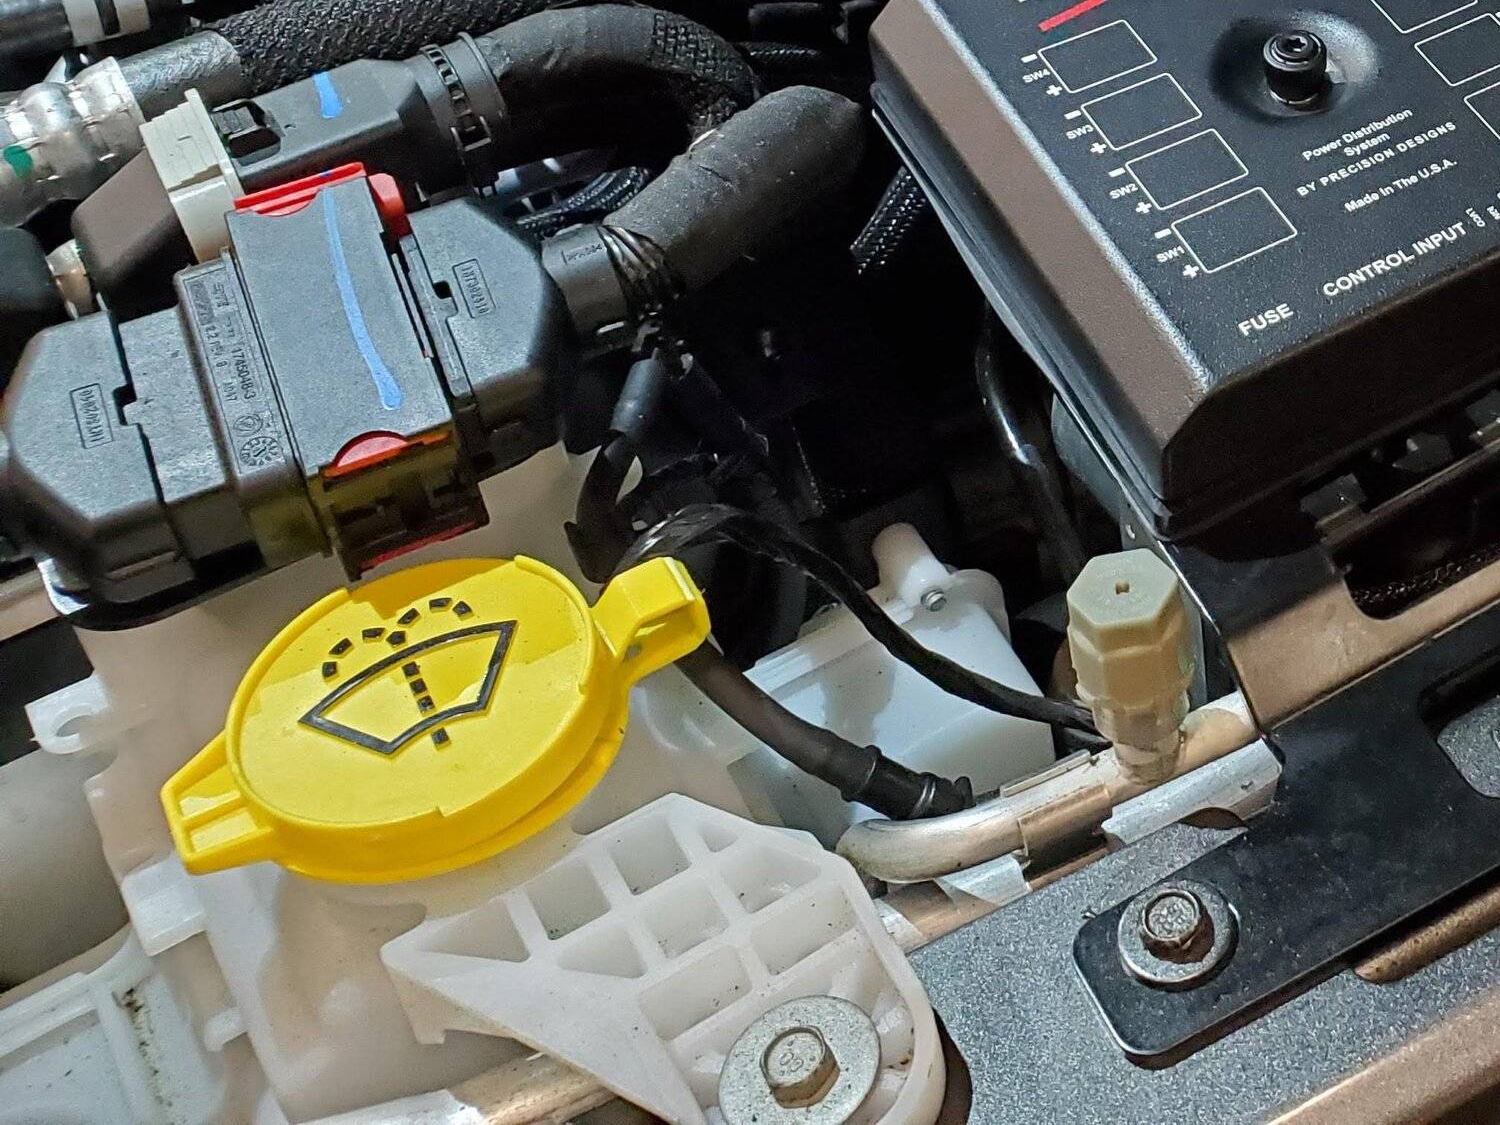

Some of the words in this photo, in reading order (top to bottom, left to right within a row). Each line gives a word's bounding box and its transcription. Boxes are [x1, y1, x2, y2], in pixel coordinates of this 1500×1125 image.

[1022, 67, 1051, 84] SW4
[1065, 123, 1094, 141] SW3
[1302, 138, 1343, 161] Power
[1341, 109, 1414, 144] Distribution
[1343, 132, 1391, 157] System
[1296, 181, 1317, 197] BY
[1319, 148, 1395, 187] PRECISION
[1396, 121, 1457, 153] DESIGNS
[1108, 182, 1138, 200] SW2
[1344, 192, 1380, 212] Made
[1379, 184, 1395, 197] In
[1392, 174, 1419, 191] The
[1417, 158, 1458, 179] U.S.A.
[1156, 245, 1185, 263] SW1
[1322, 251, 1414, 298] CONTROL
[1411, 220, 1468, 259] INPUT
[1237, 302, 1294, 337] FUSE
